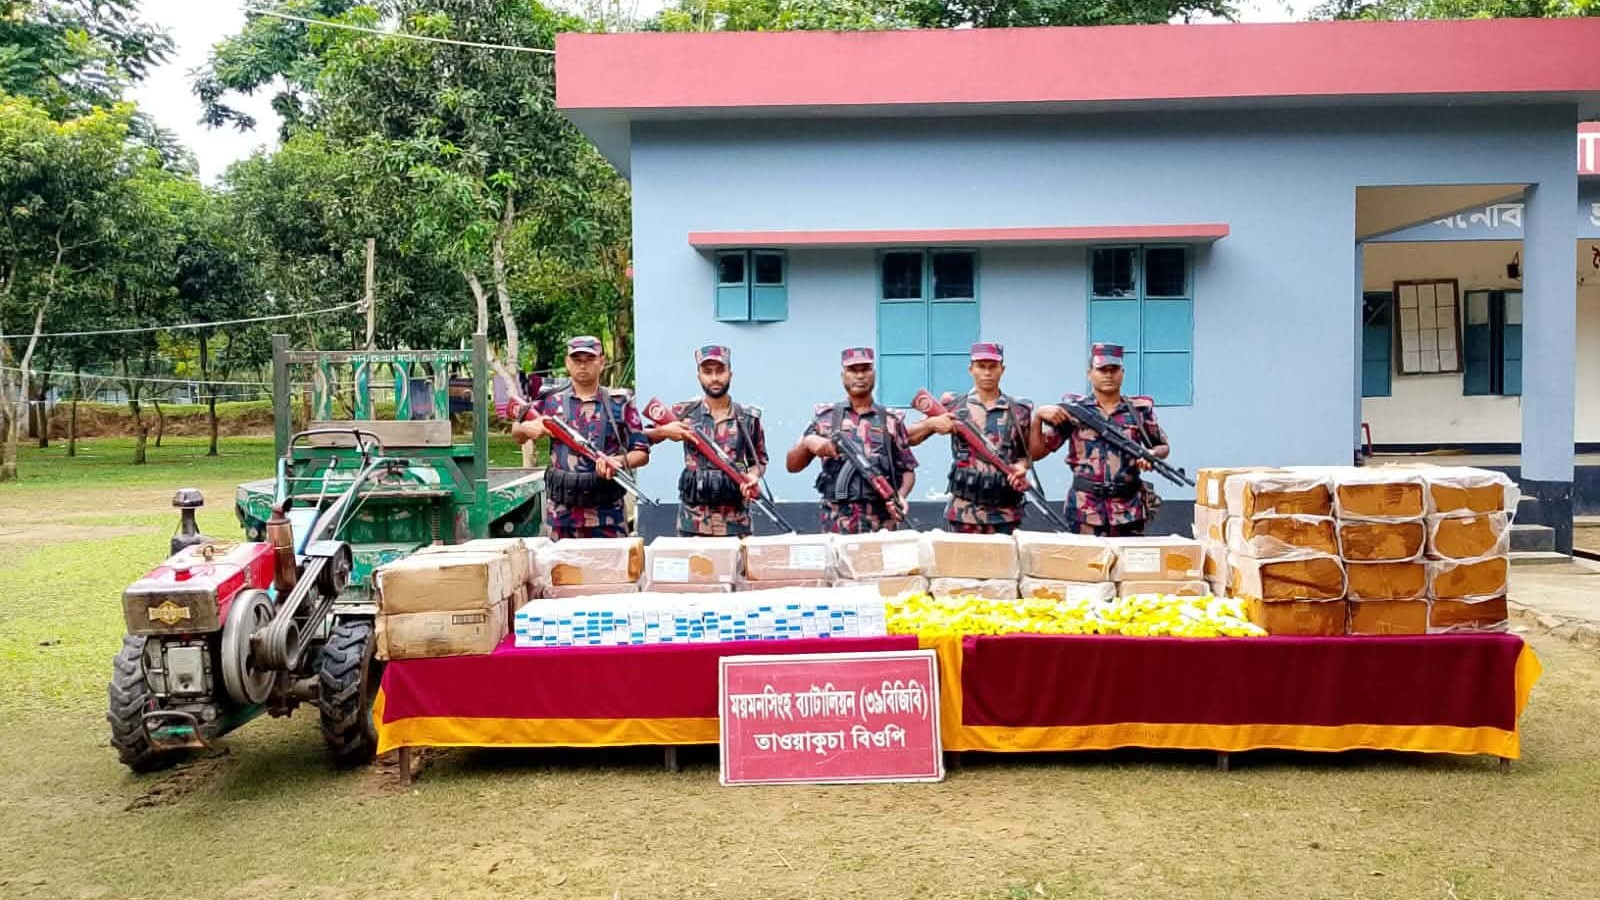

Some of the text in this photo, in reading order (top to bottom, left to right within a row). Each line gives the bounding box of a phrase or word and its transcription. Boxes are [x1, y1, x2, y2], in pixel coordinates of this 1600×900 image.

[728, 684, 793, 722] ময়মনসিংহ
[795, 682, 856, 718] ব্যাটালিয়ন
[752, 723, 906, 755] তাওয়াকুচা বিওপি
